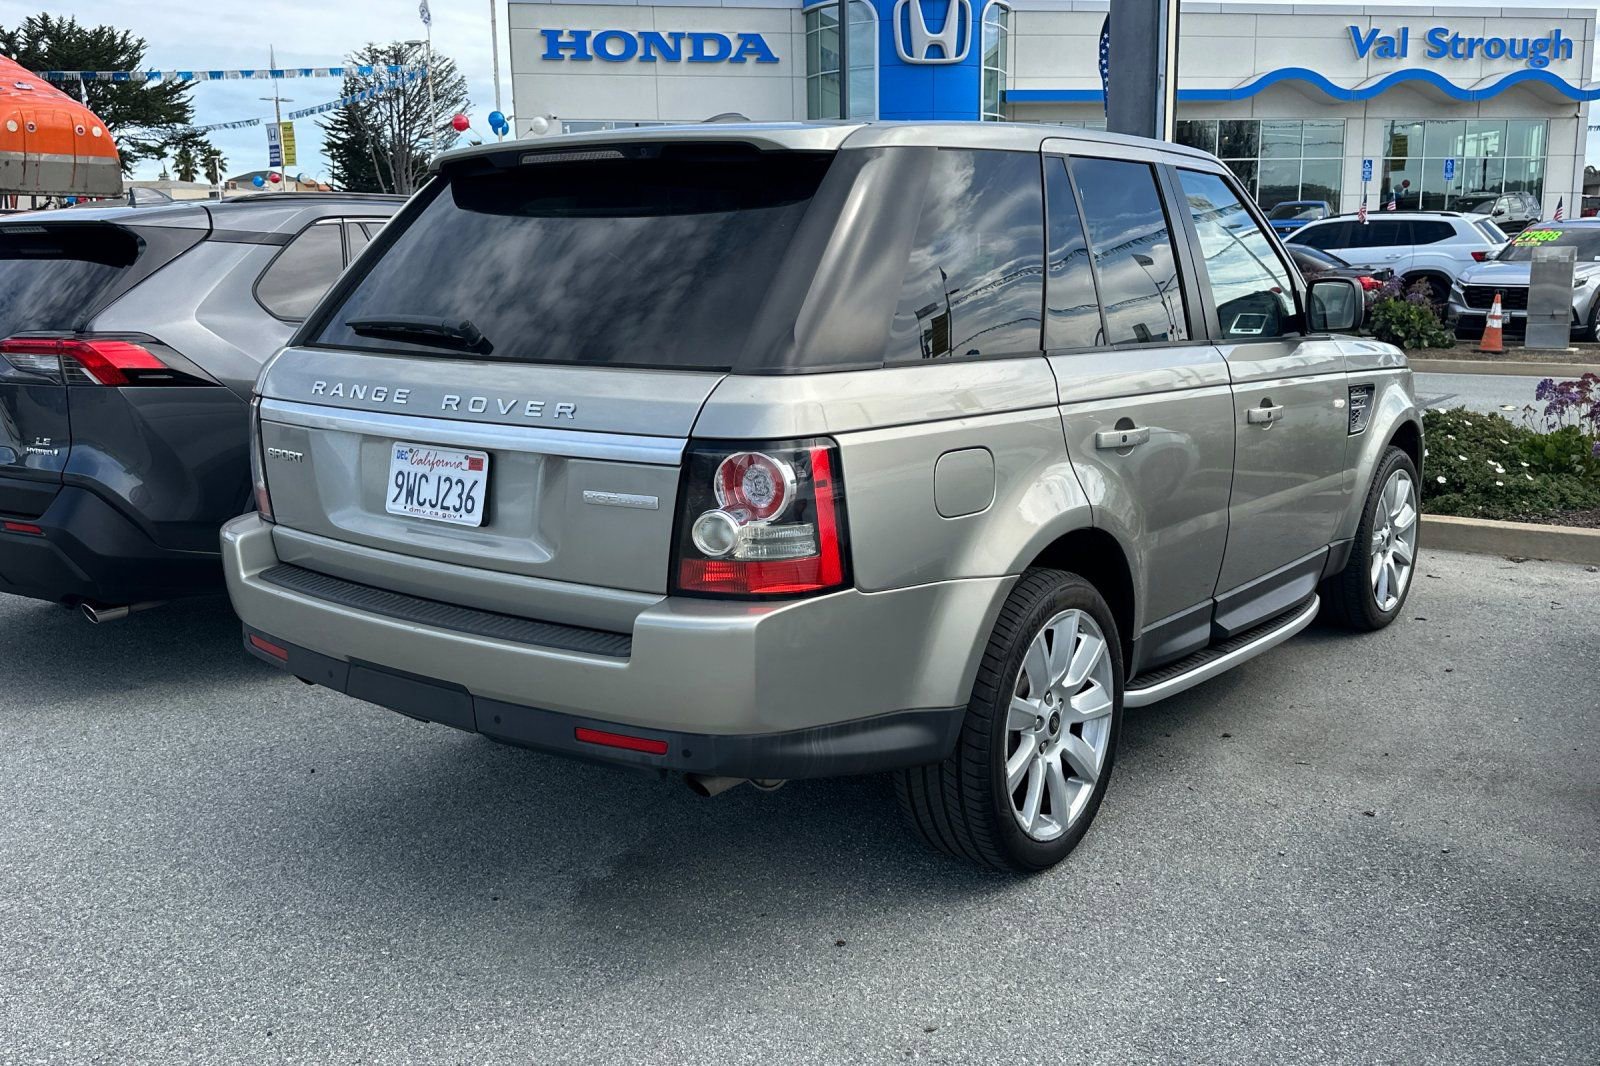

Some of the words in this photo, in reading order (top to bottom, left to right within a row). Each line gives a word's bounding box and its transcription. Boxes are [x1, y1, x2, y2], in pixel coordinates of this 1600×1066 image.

[541, 29, 780, 64] HONDA
[1347, 25, 1409, 60] Val
[1424, 26, 1573, 69] Strough
[311, 380, 411, 405] RANGE
[441, 394, 577, 420] ROVER
[35, 437, 52, 446] LE
[267, 447, 304, 464] SPORT
[396, 449, 409, 461] DEC
[410, 449, 469, 473] California
[392, 470, 479, 514] 9WCJ236
[408, 507, 458, 519] dmv.ca.gov
